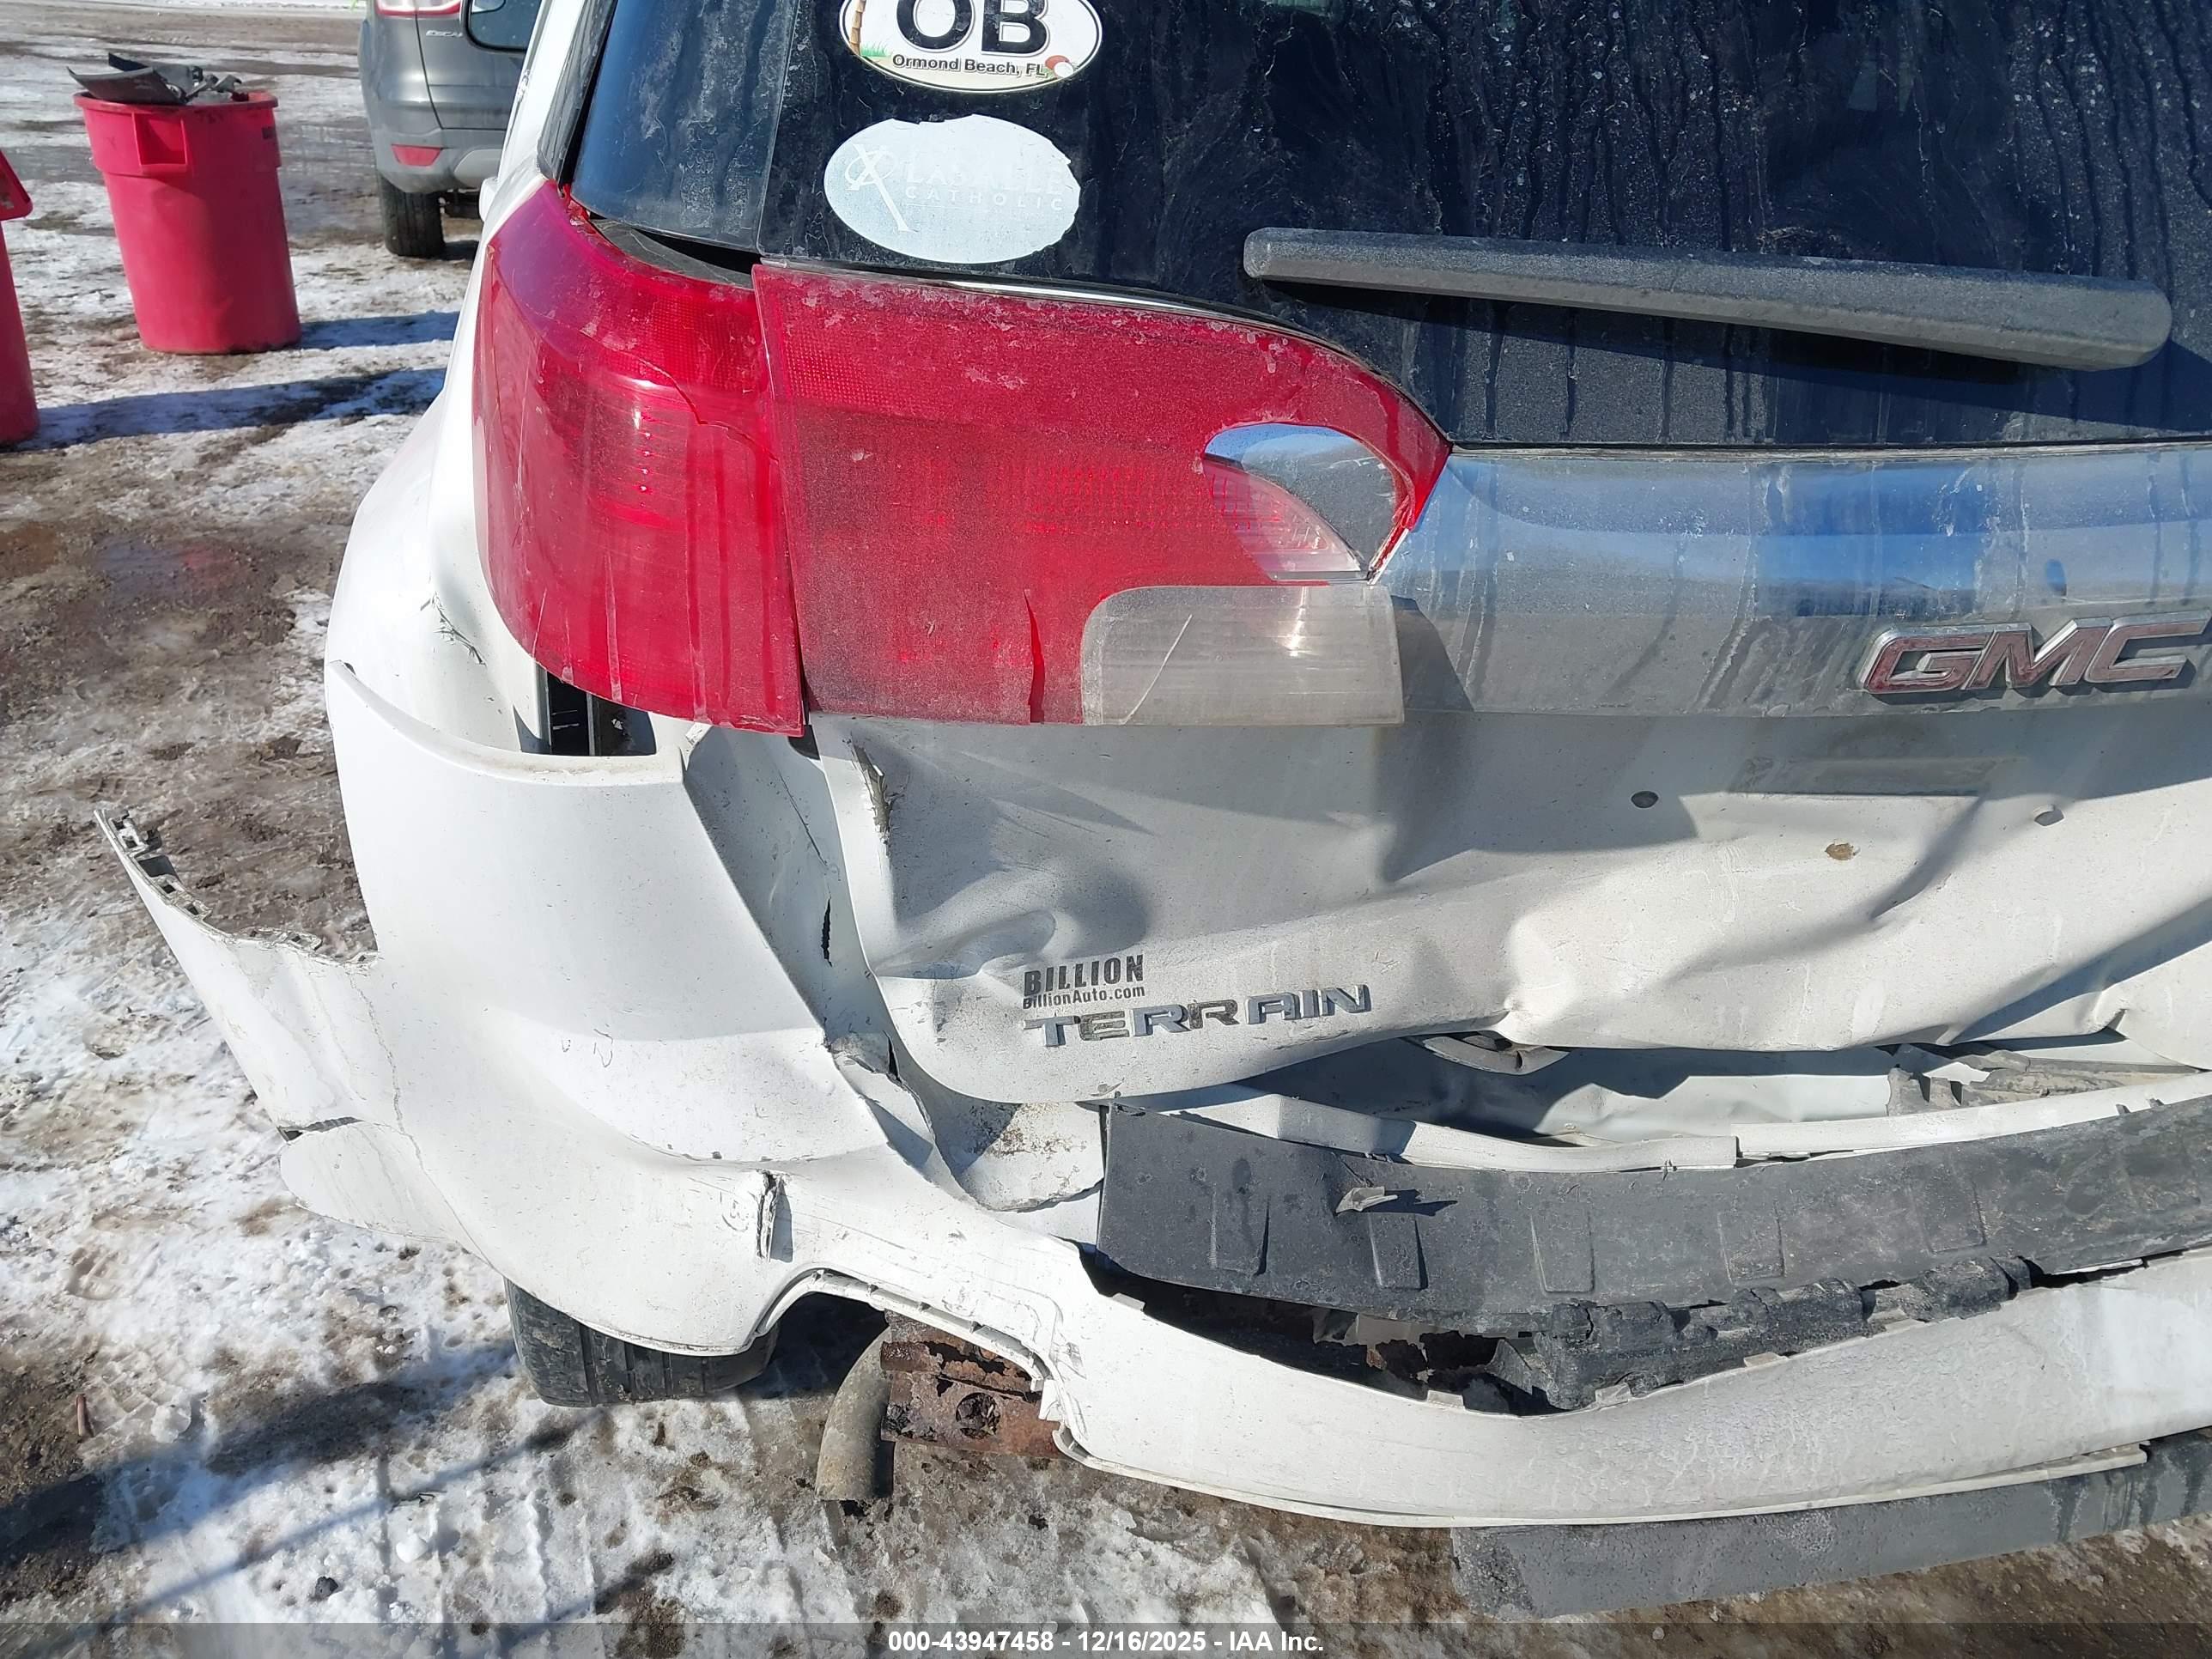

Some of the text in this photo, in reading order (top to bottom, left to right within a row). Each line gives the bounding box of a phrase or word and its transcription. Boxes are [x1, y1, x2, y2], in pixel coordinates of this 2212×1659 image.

[896, 0, 1048, 53] OB
[892, 54, 1046, 76] Ormond Beach, FL
[904, 185, 1064, 212] CATHOLIC
[1860, 609, 2212, 694] GMC
[1024, 954, 1144, 996] BILLION
[1022, 986, 1146, 1009] BillionAuto.com
[1023, 984, 1372, 1048] TERRAIN
